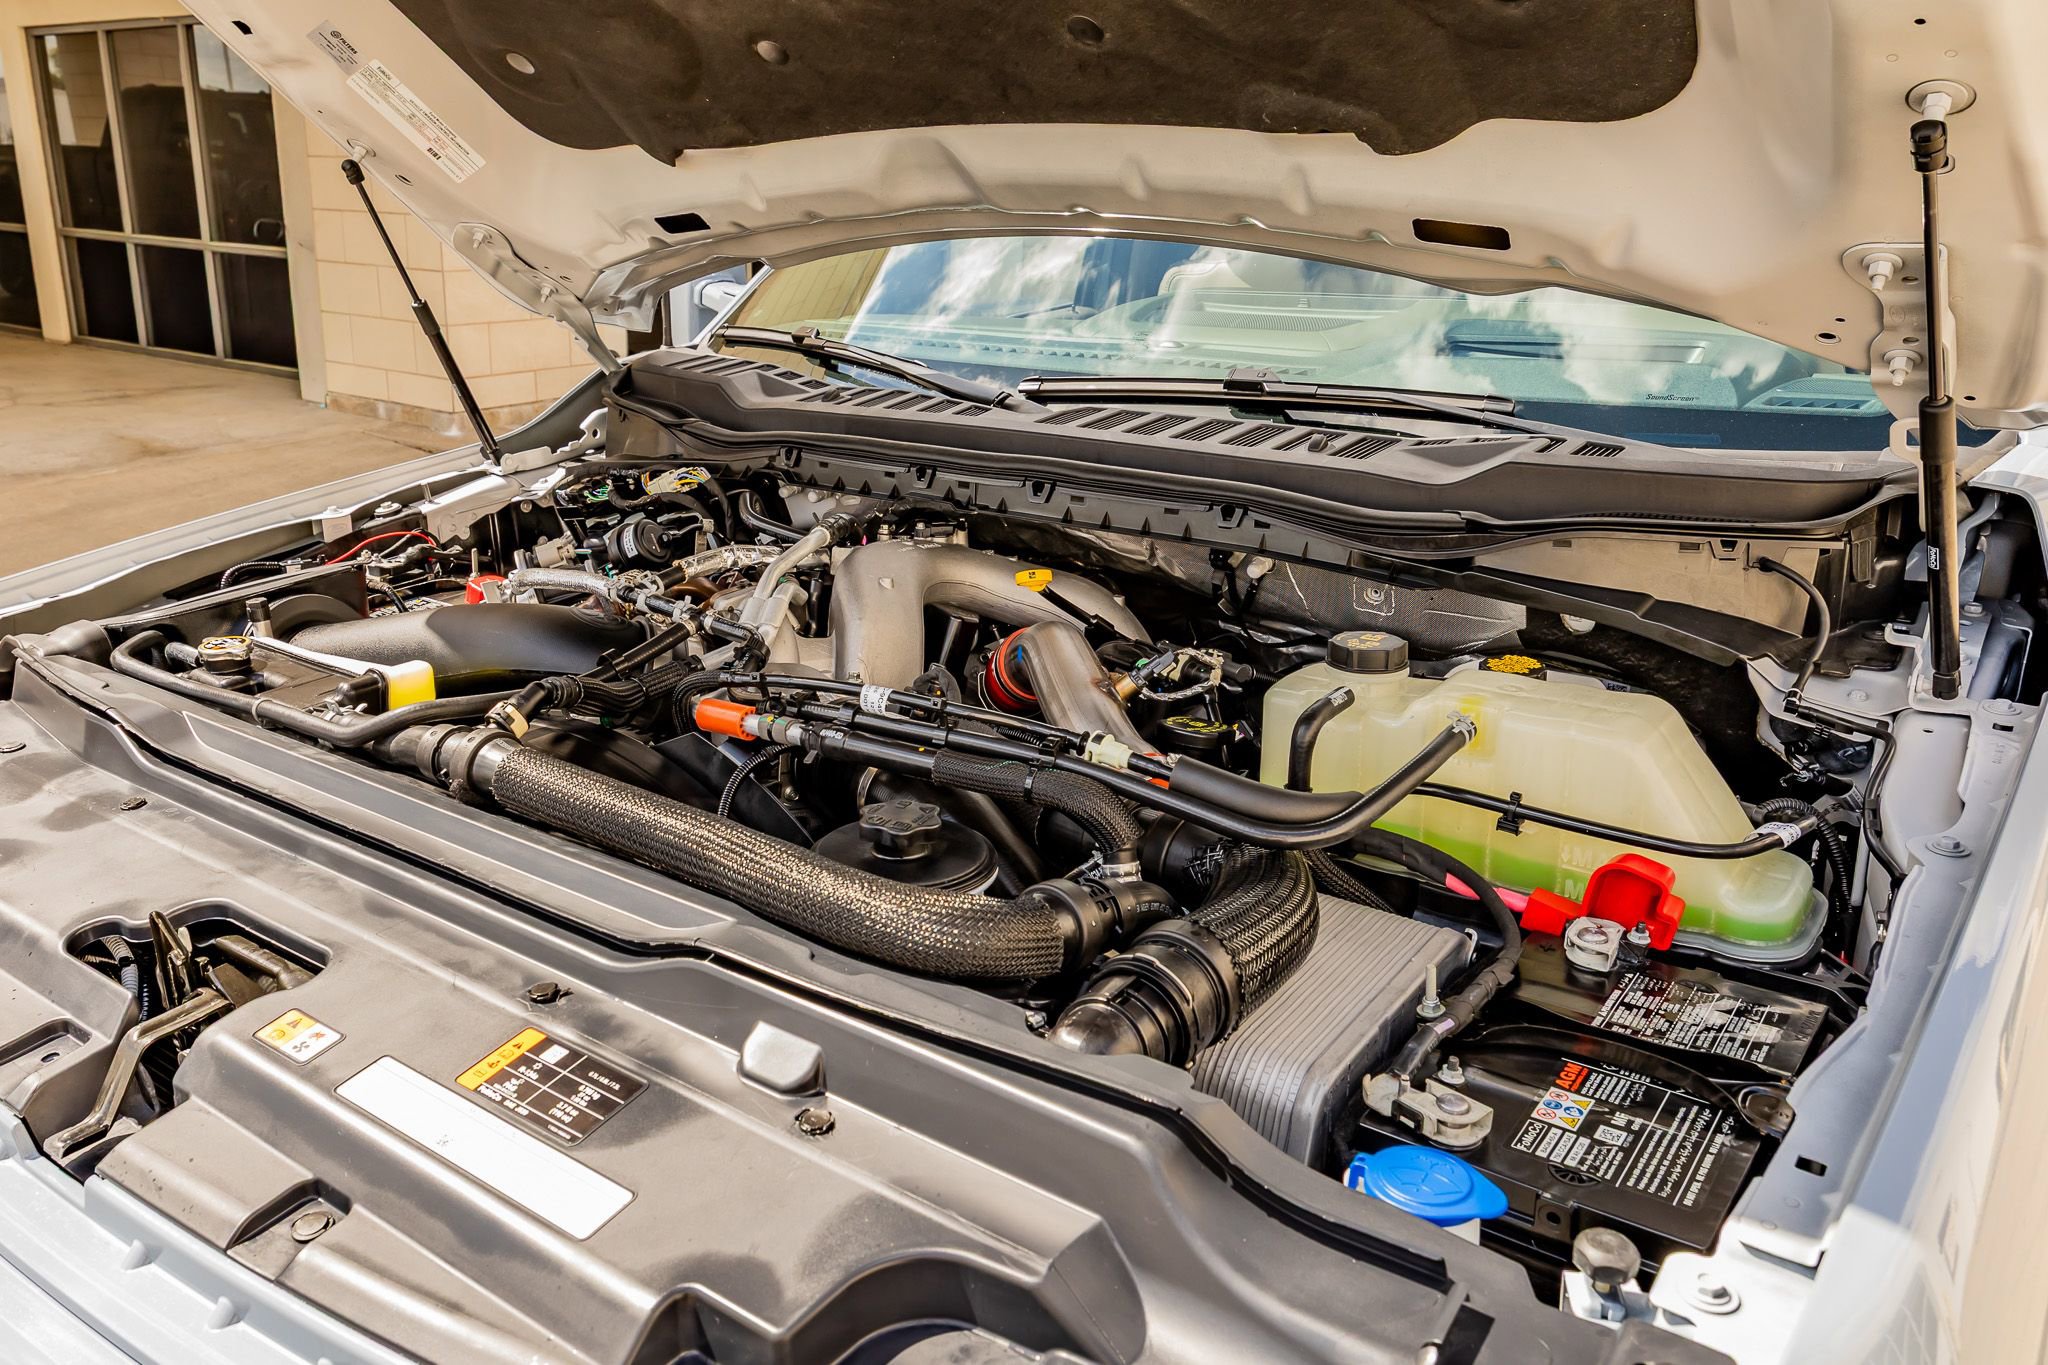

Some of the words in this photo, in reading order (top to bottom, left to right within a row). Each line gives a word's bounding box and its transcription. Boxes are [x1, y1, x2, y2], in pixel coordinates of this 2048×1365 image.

[338, 36, 358, 55] FILTERS
[1645, 393, 1695, 402] SoundScreen
[1553, 1061, 1583, 1089] AGM
[1515, 1120, 1544, 1150] FoMoCo
